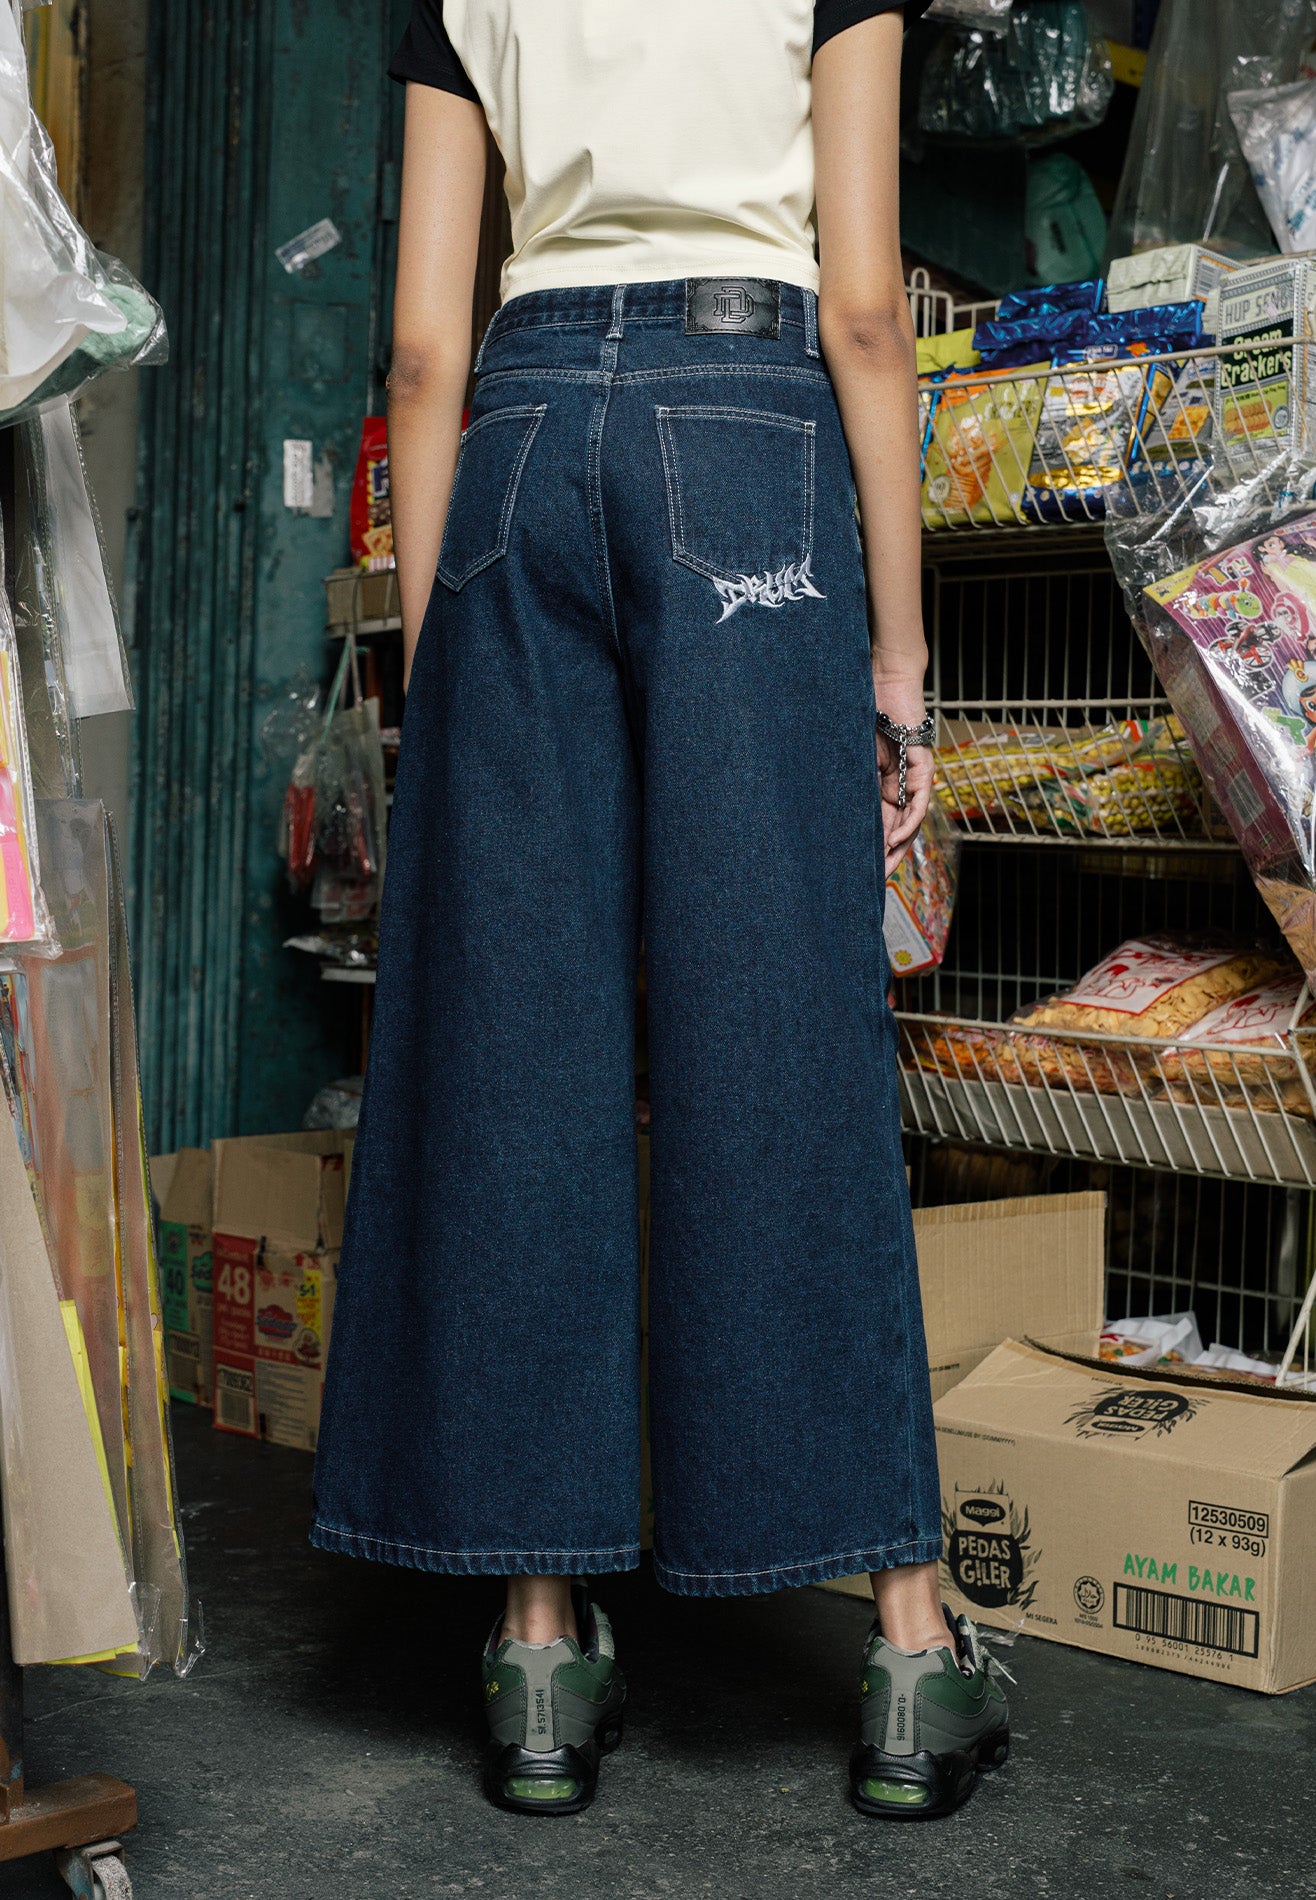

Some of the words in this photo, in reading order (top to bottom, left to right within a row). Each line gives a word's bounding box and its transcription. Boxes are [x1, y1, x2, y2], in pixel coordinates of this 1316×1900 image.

[1224, 299, 1251, 326] HUP
[1220, 351, 1293, 388] Crackers
[217, 1263, 251, 1304] 48
[1103, 1405, 1170, 1422] PEDAS
[965, 1505, 1000, 1518] Maggi
[1191, 1505, 1266, 1533] 12530509
[958, 1535, 1011, 1560] PEDAS
[1189, 1527, 1214, 1545] (12
[1218, 1535, 1228, 1547] x
[1231, 1534, 1267, 1558] 93g)
[1123, 1553, 1178, 1585] AYAM
[1188, 1565, 1256, 1602] BAKAR
[1194, 1647, 1223, 1661] 25576
